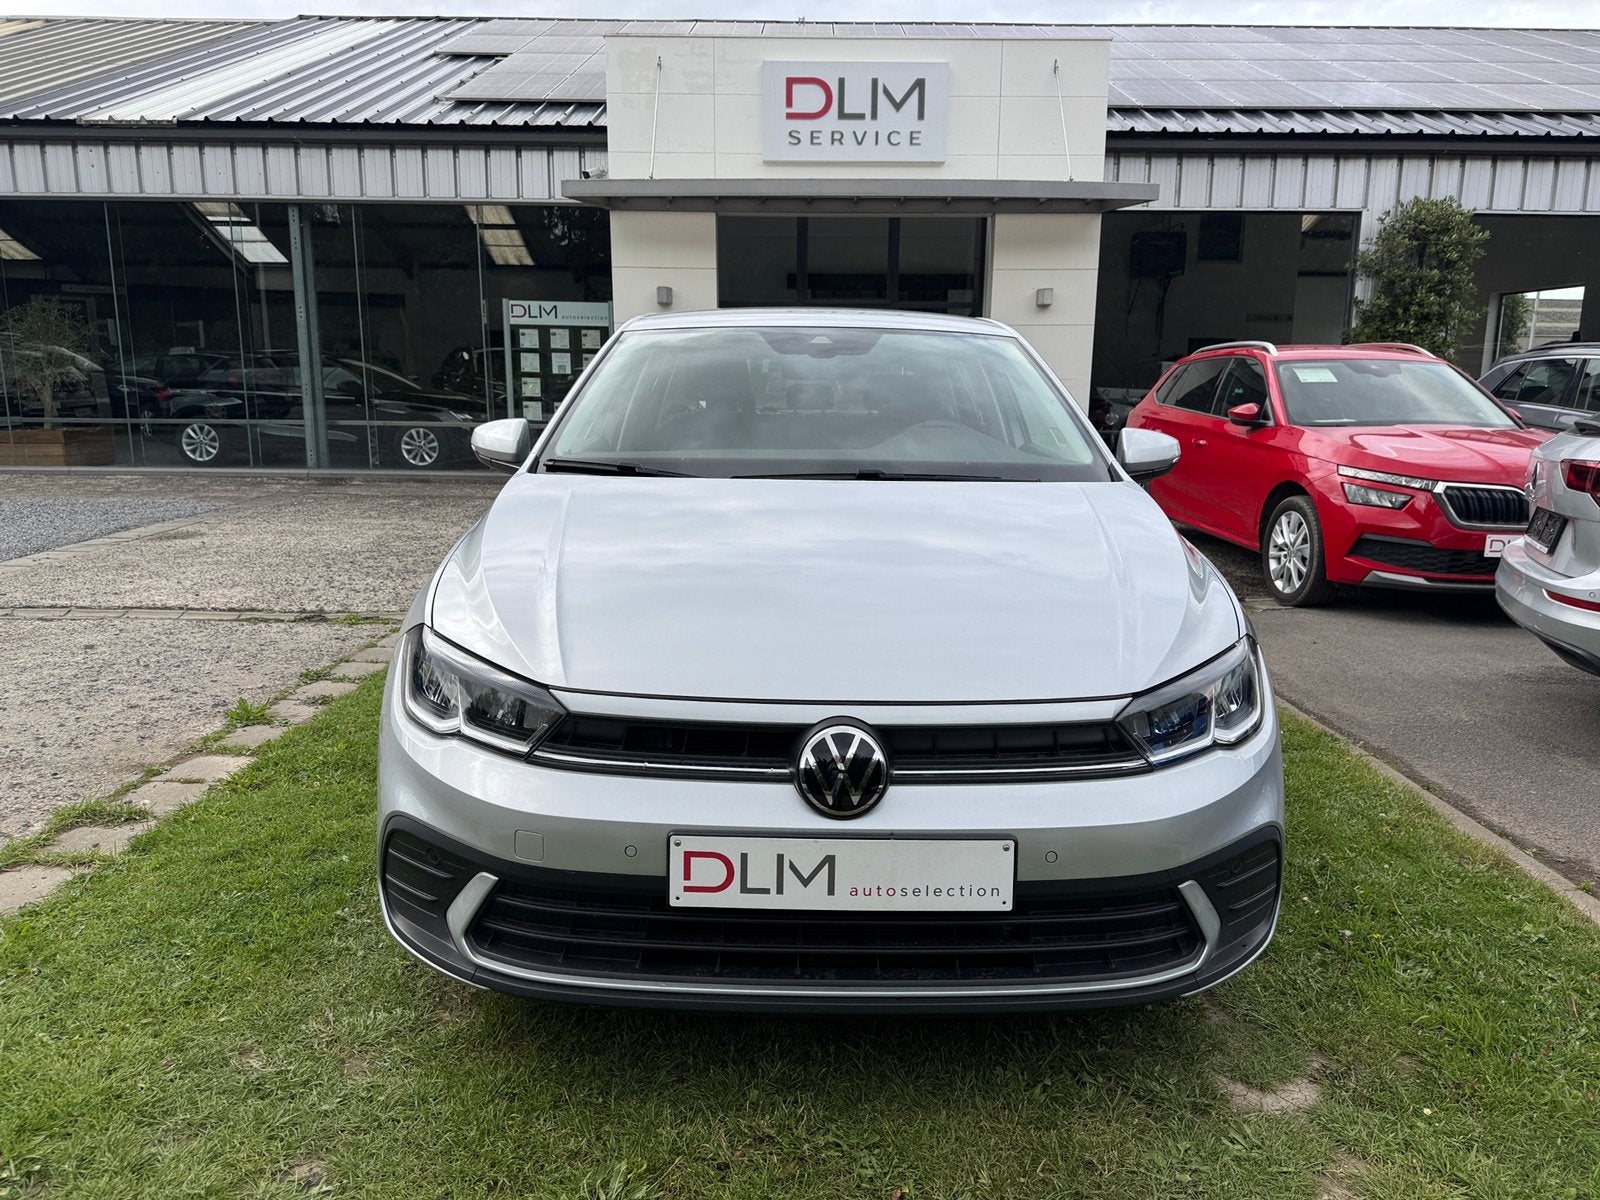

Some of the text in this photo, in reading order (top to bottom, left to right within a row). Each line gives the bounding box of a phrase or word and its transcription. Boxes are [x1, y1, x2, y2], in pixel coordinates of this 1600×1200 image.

[788, 130, 923, 146] SERVICE
[1489, 539, 1510, 553] D
[849, 883, 1002, 898] autoselection
